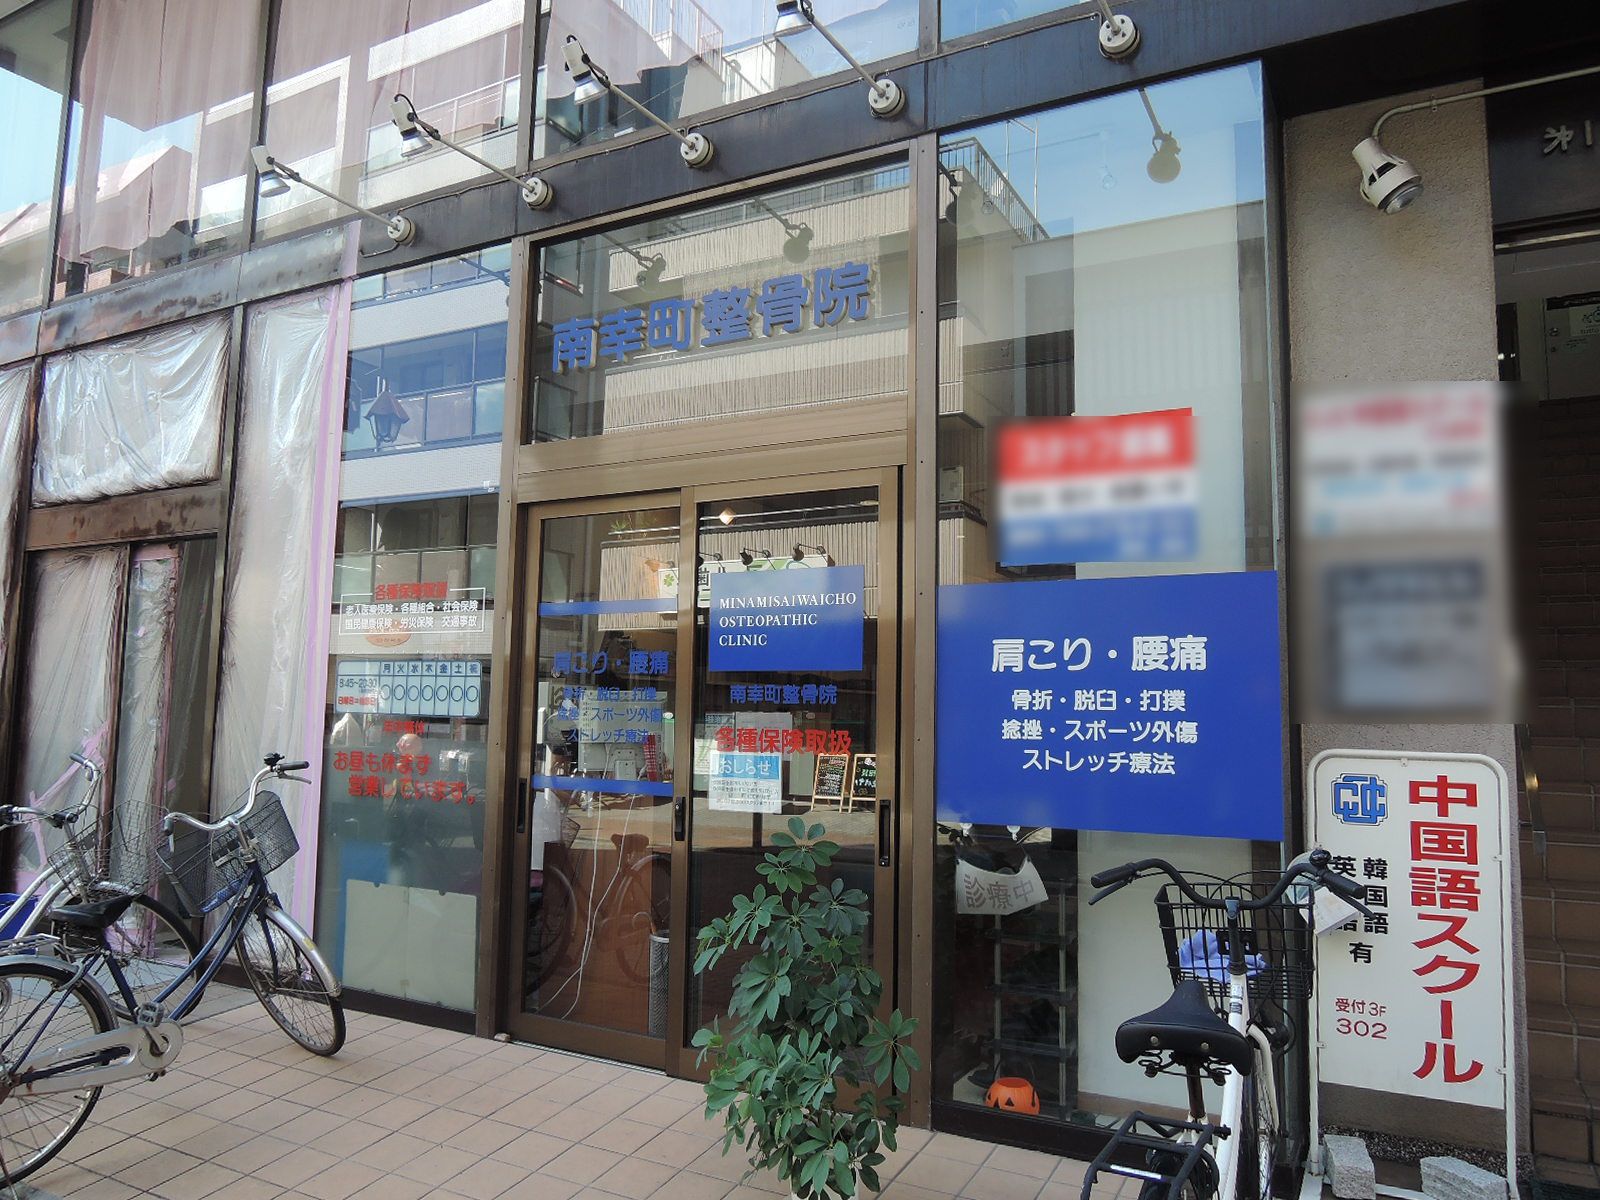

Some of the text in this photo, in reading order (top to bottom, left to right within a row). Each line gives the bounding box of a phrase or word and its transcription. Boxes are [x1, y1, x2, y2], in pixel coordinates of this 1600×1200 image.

[552, 261, 870, 375] 南幸町整骨院
[719, 592, 856, 609] MINAMISAIWAICHO
[719, 614, 817, 628] OSTEOPATHIC
[719, 634, 768, 647] CLINIC
[553, 650, 669, 675] 肩こり・腰痛
[991, 635, 1208, 672] 肩こり・腰痛
[382, 662, 391, 674] 月
[396, 662, 406, 674] 火
[410, 662, 420, 674] 水
[424, 662, 434, 674] 木
[439, 662, 449, 674] 金
[454, 662, 463, 674] 土
[730, 684, 838, 704] 南幸町整骨院
[1011, 689, 1186, 712] 骨折・脱臼・打撲
[568, 728, 650, 744] ストレッチ療法
[715, 727, 852, 756] 各種保険取扱
[1001, 719, 1198, 744] 捻挫・スポーツ外傷
[719, 758, 771, 776] おしらせ
[1022, 749, 1176, 775] ストレッチ療法
[964, 873, 1034, 909] 診療中
[1363, 857, 1389, 935] 韓国語
[1408, 774, 1484, 1084] 中国語スクール
[1349, 941, 1374, 965] 有
[1336, 1018, 1388, 1040] 302
